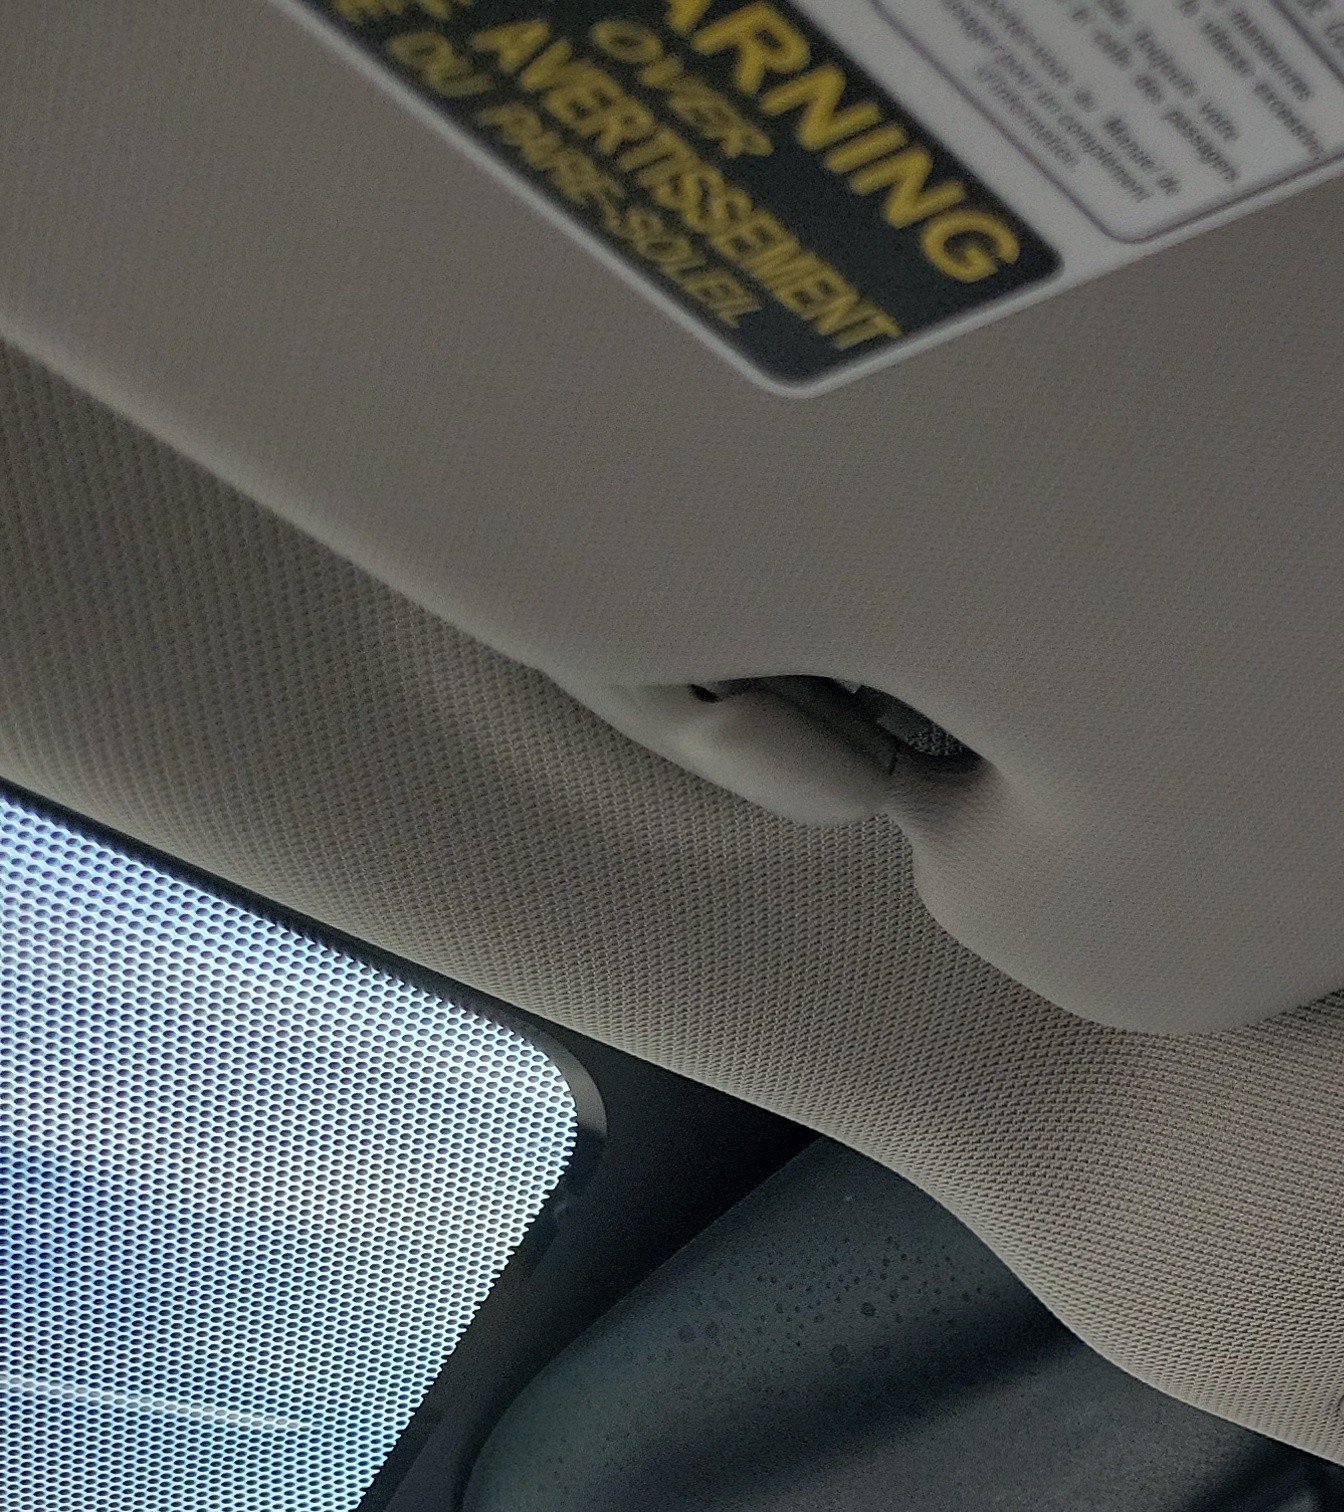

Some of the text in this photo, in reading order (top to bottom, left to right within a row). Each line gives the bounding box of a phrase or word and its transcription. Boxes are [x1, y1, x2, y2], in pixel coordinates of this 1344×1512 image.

[389, 30, 764, 330] DU PARE-SOLEIL
[470, 18, 902, 351] AVERTISSEMENT
[591, 20, 775, 158] OVER
